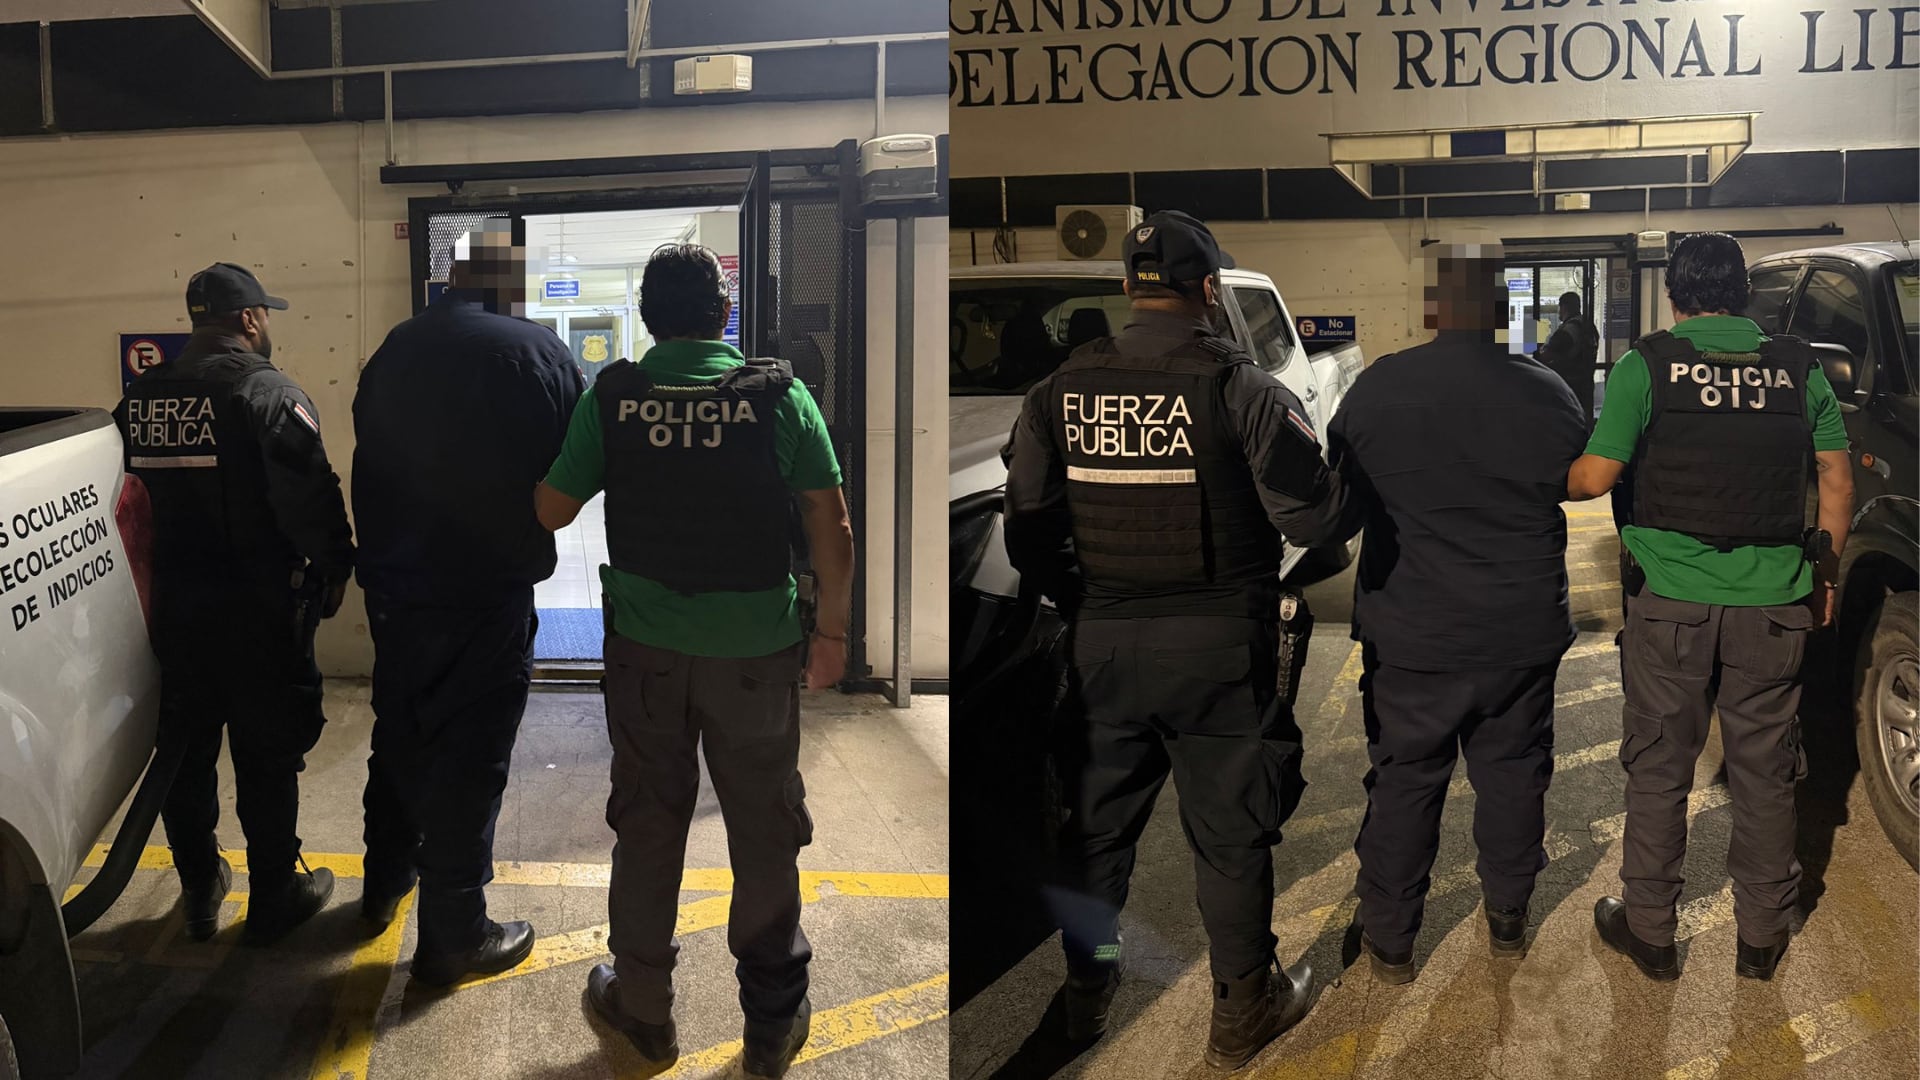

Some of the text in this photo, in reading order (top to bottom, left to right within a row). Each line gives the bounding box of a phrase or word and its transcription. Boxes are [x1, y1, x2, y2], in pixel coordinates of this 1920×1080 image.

[949, 32, 1362, 107] ELEGACION
[1393, 14, 1762, 90] REGIONAL
[1138, 271, 1160, 280] POLICIA
[1328, 318, 1344, 328] No
[1670, 362, 1794, 388] POLICIA
[128, 397, 215, 422] FUERZA
[618, 399, 758, 423] POLICIA
[1063, 393, 1193, 425] FUERZA
[129, 421, 216, 446] PUBLICA
[1065, 423, 1194, 456] PUBLICA
[12, 483, 98, 539] OCULARES
[11, 549, 114, 631] DE INDICIOS
